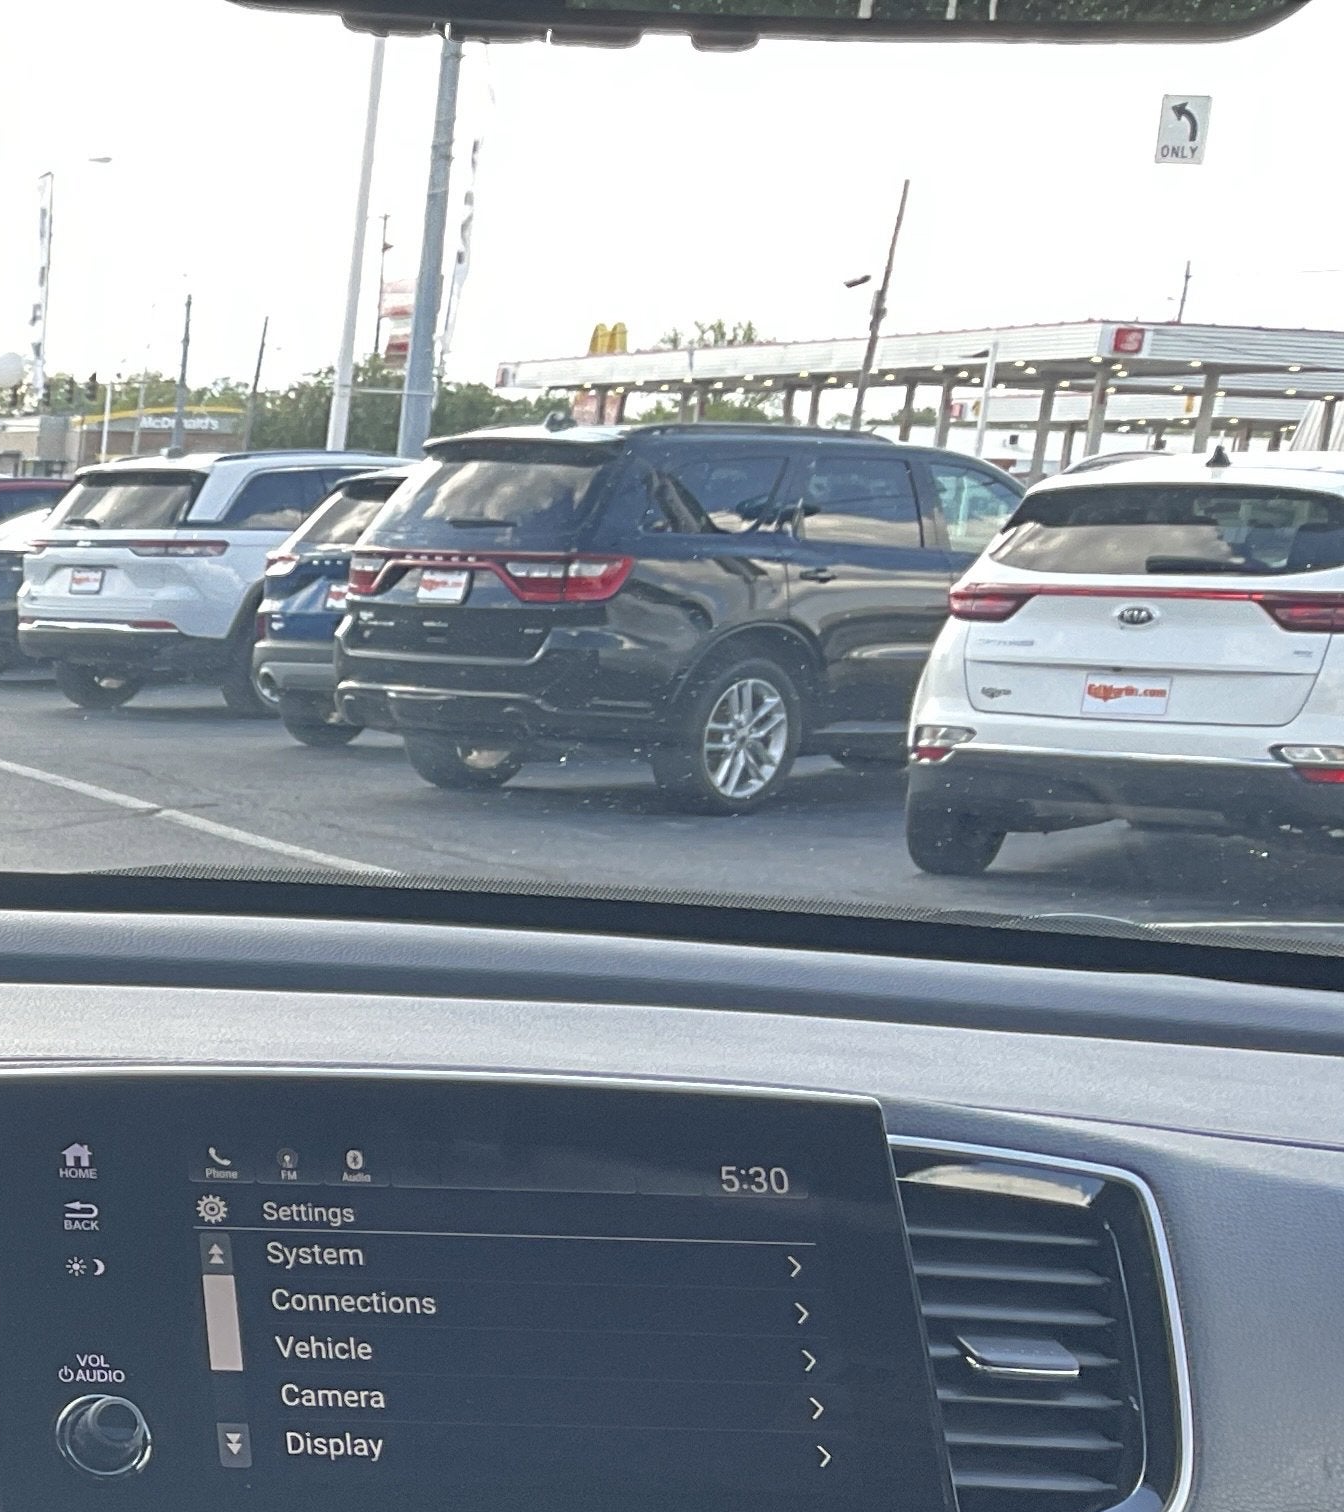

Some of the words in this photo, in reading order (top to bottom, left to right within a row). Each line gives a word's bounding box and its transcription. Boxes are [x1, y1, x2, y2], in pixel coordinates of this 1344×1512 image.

[1161, 144, 1198, 158] ONLY
[140, 416, 219, 430] McDnald's
[59, 1168, 97, 1178] HOME
[206, 1168, 238, 1179] Phone
[281, 1170, 297, 1179] FM
[342, 1172, 371, 1182] Audio
[722, 1166, 789, 1194] 5:30
[263, 1202, 354, 1226] Settings
[64, 1220, 98, 1230] BACK
[267, 1242, 363, 1269] System
[272, 1289, 436, 1314] Connections
[275, 1336, 372, 1360] Vehicle
[76, 1354, 109, 1367] VOL
[76, 1369, 125, 1382] AUDIO
[282, 1384, 385, 1408] Camera
[286, 1432, 382, 1461] Display
